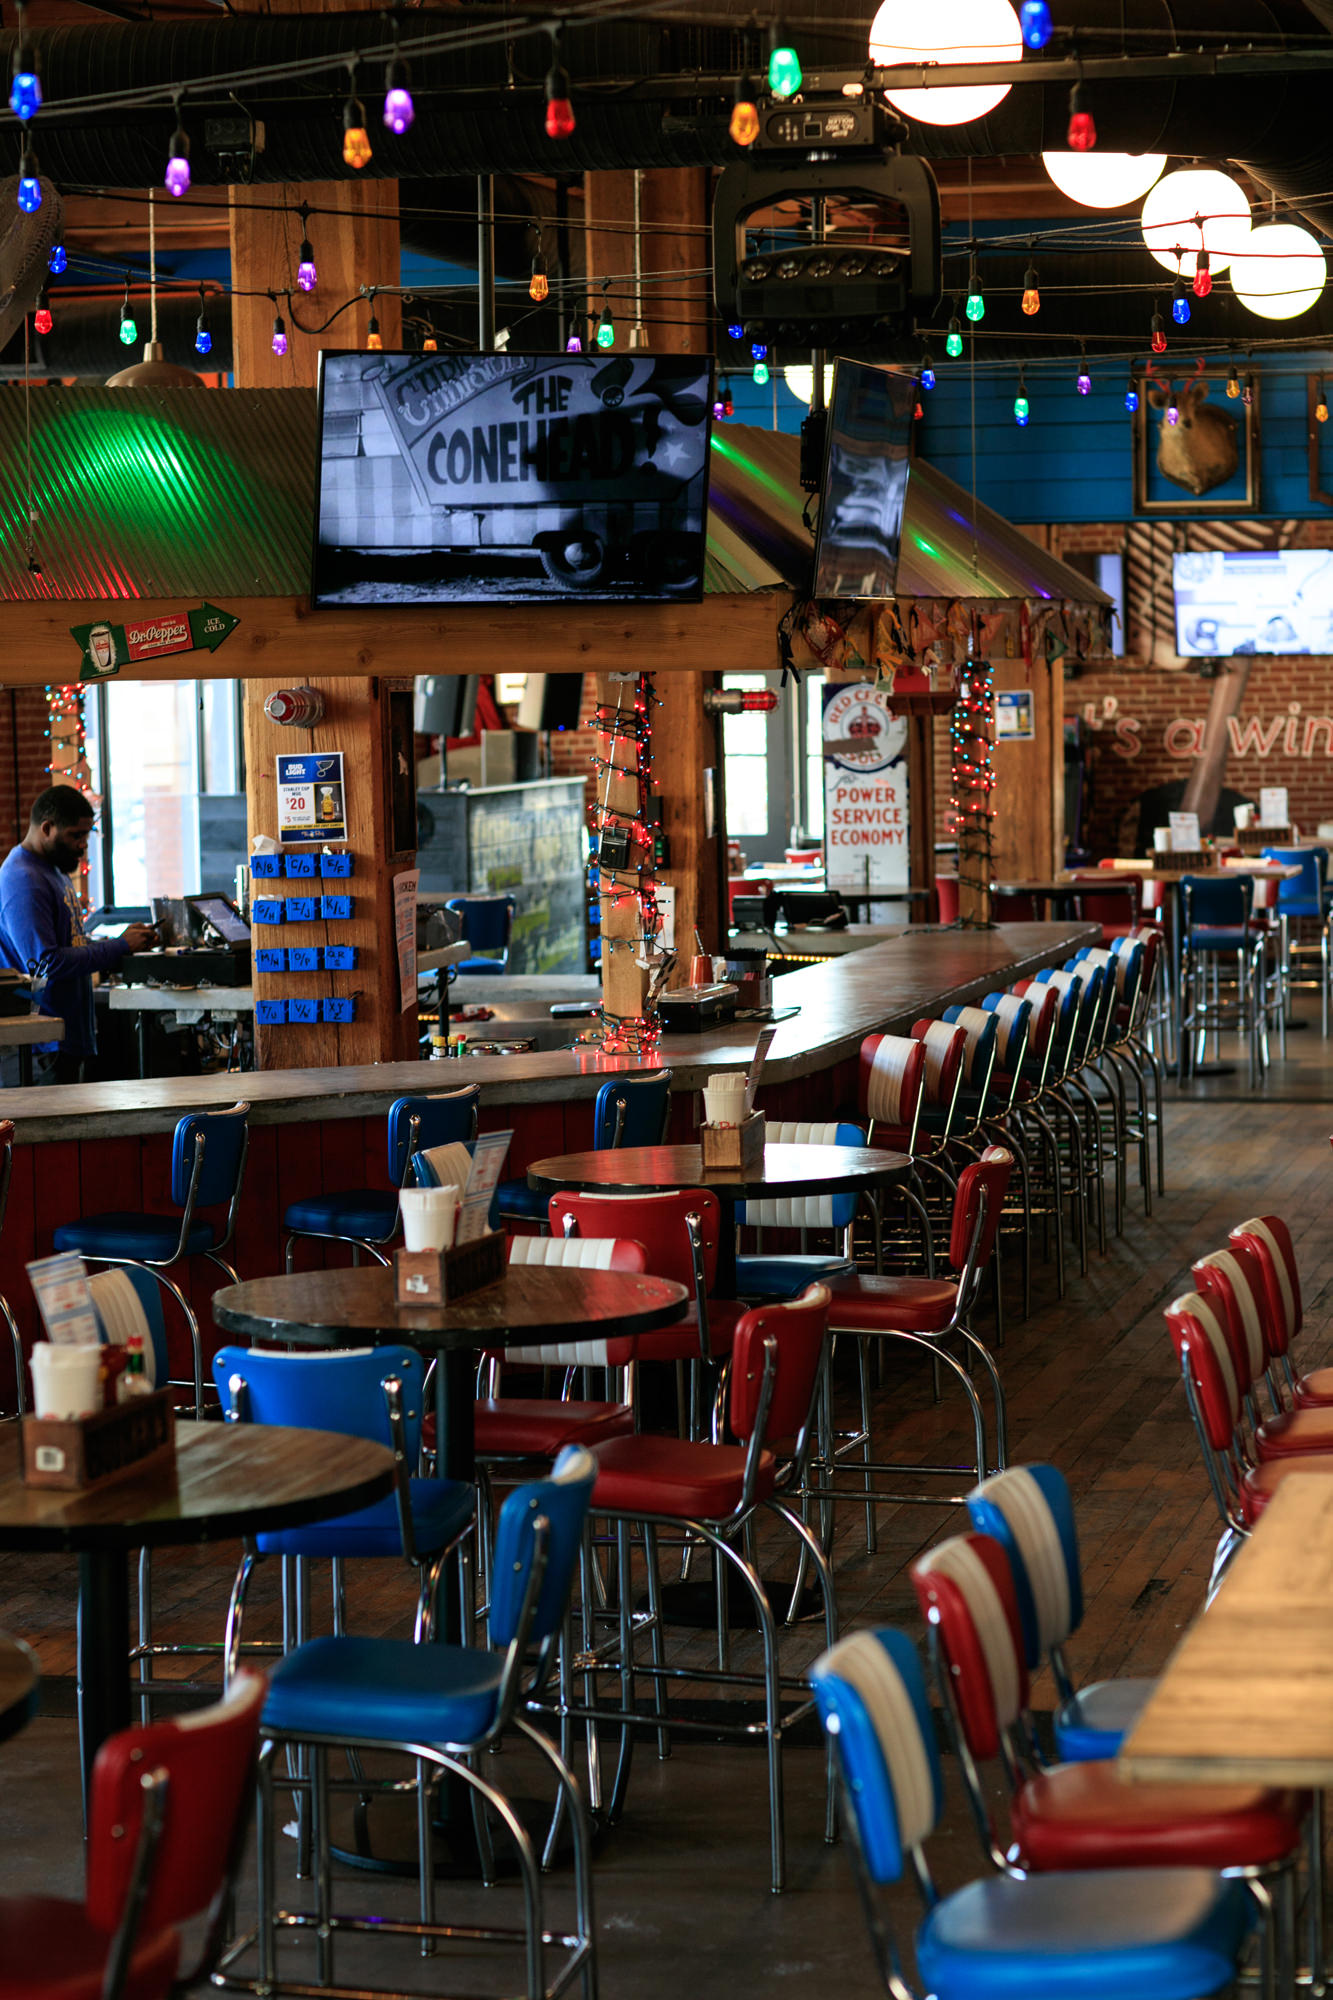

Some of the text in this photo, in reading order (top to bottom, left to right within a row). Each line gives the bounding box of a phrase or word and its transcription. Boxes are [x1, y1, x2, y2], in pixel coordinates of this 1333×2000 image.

[512, 375, 573, 415] THE
[204, 623, 225, 633] COLD
[208, 617, 220, 625] ICE
[829, 696, 852, 724] RED
[837, 787, 895, 803] POWER
[832, 808, 902, 824] SERVICE
[831, 829, 904, 845] ECONOMY
[255, 861, 274, 875] A/B
[291, 859, 310, 873] C/D
[327, 859, 345, 873] E/F
[257, 904, 275, 920] G/H
[292, 902, 310, 918] I/J
[326, 900, 345, 915] K/L
[260, 953, 279, 966] M/N
[294, 953, 310, 966] O/P
[261, 1006, 277, 1019] T/U
